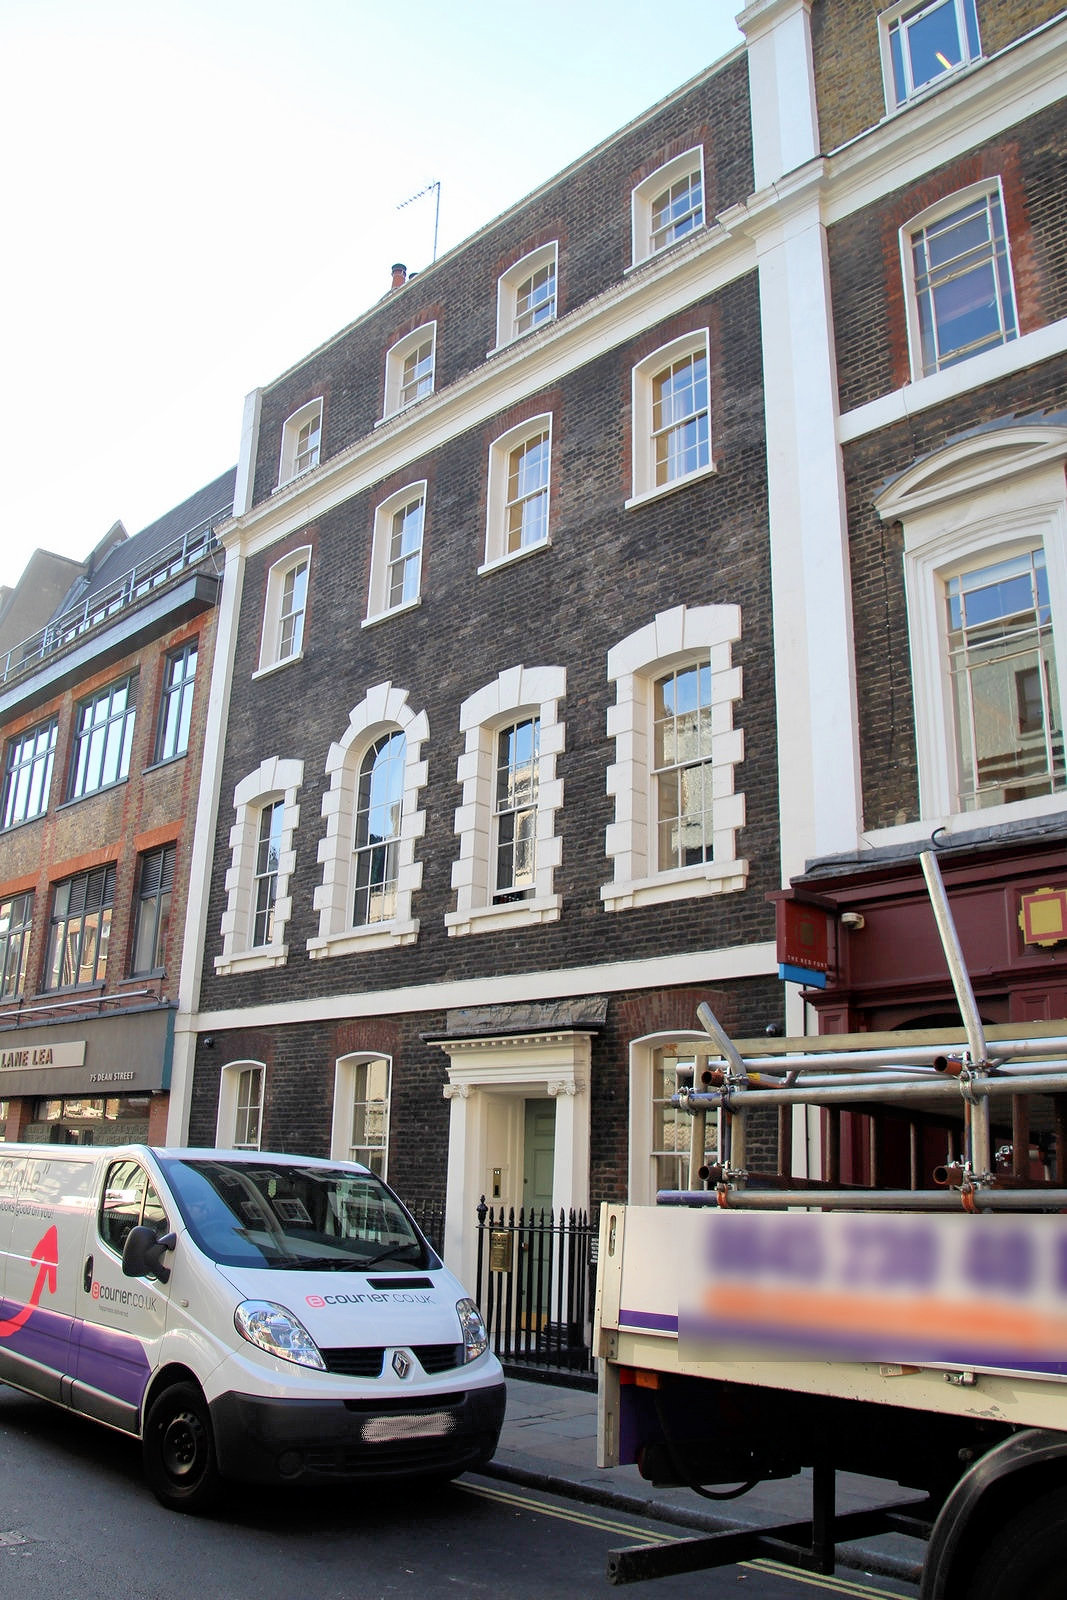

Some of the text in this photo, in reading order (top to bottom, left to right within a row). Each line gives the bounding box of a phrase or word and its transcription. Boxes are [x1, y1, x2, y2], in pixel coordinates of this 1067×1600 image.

[787, 954, 798, 962] THE
[1, 1048, 53, 1068] LANE LEA
[90, 1071, 134, 1082] 75 DEAN STREET
